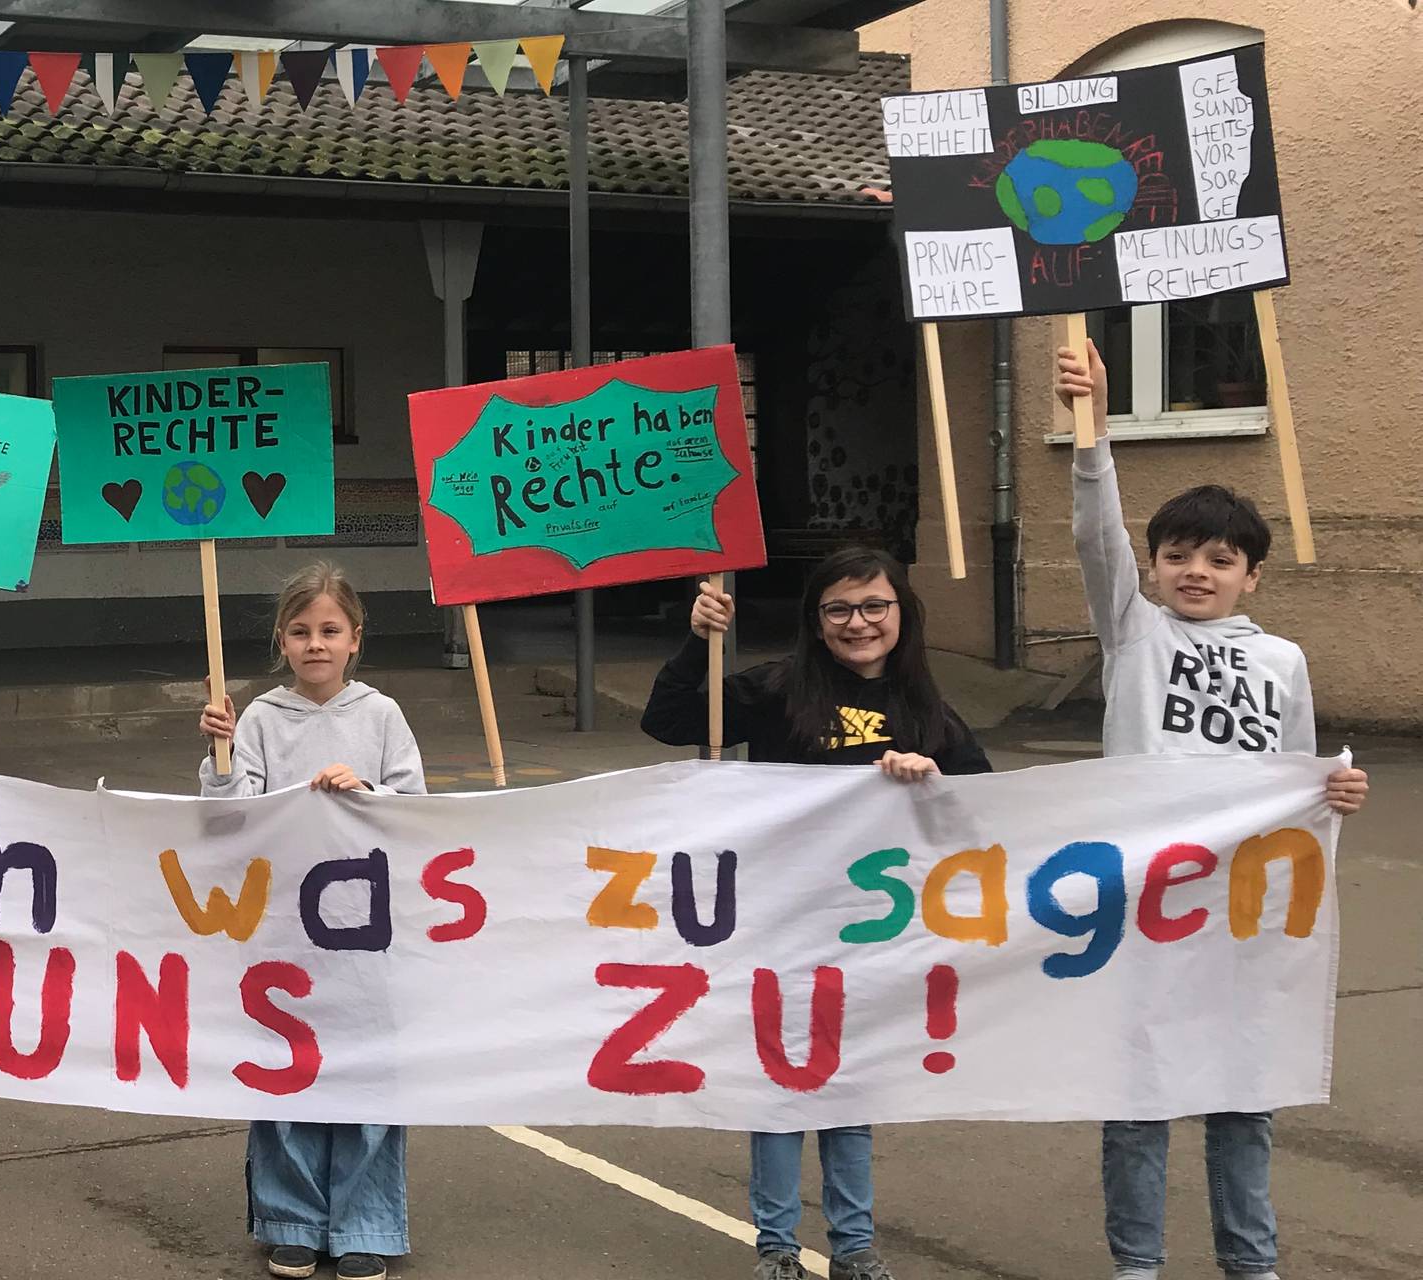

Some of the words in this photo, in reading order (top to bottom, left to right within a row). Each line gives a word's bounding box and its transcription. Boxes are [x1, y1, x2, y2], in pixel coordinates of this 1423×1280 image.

[1021, 77, 1115, 111] BILDUNG
[1193, 71, 1238, 97] GE-
[882, 92, 987, 124] GEWALT-
[1193, 97, 1252, 118] SUND-
[885, 127, 991, 156] FREIHEIT
[1193, 119, 1254, 143] HEITS-
[1194, 143, 1247, 168] VOR-
[1202, 168, 1247, 192] SOR-
[1204, 195, 1234, 220] GE
[913, 238, 1006, 277] PRIVATS-
[1120, 222, 1280, 260] MEINUNGS-
[919, 279, 1000, 316] PHÄRE
[1123, 261, 1250, 301] FREIHEIT
[107, 376, 284, 417] KINDER-
[112, 413, 280, 456] RECHTE
[492, 413, 616, 458] Kinder
[633, 401, 714, 435] haben
[159, 847, 488, 952] was
[585, 846, 737, 947] zu
[839, 828, 1325, 980] sagen
